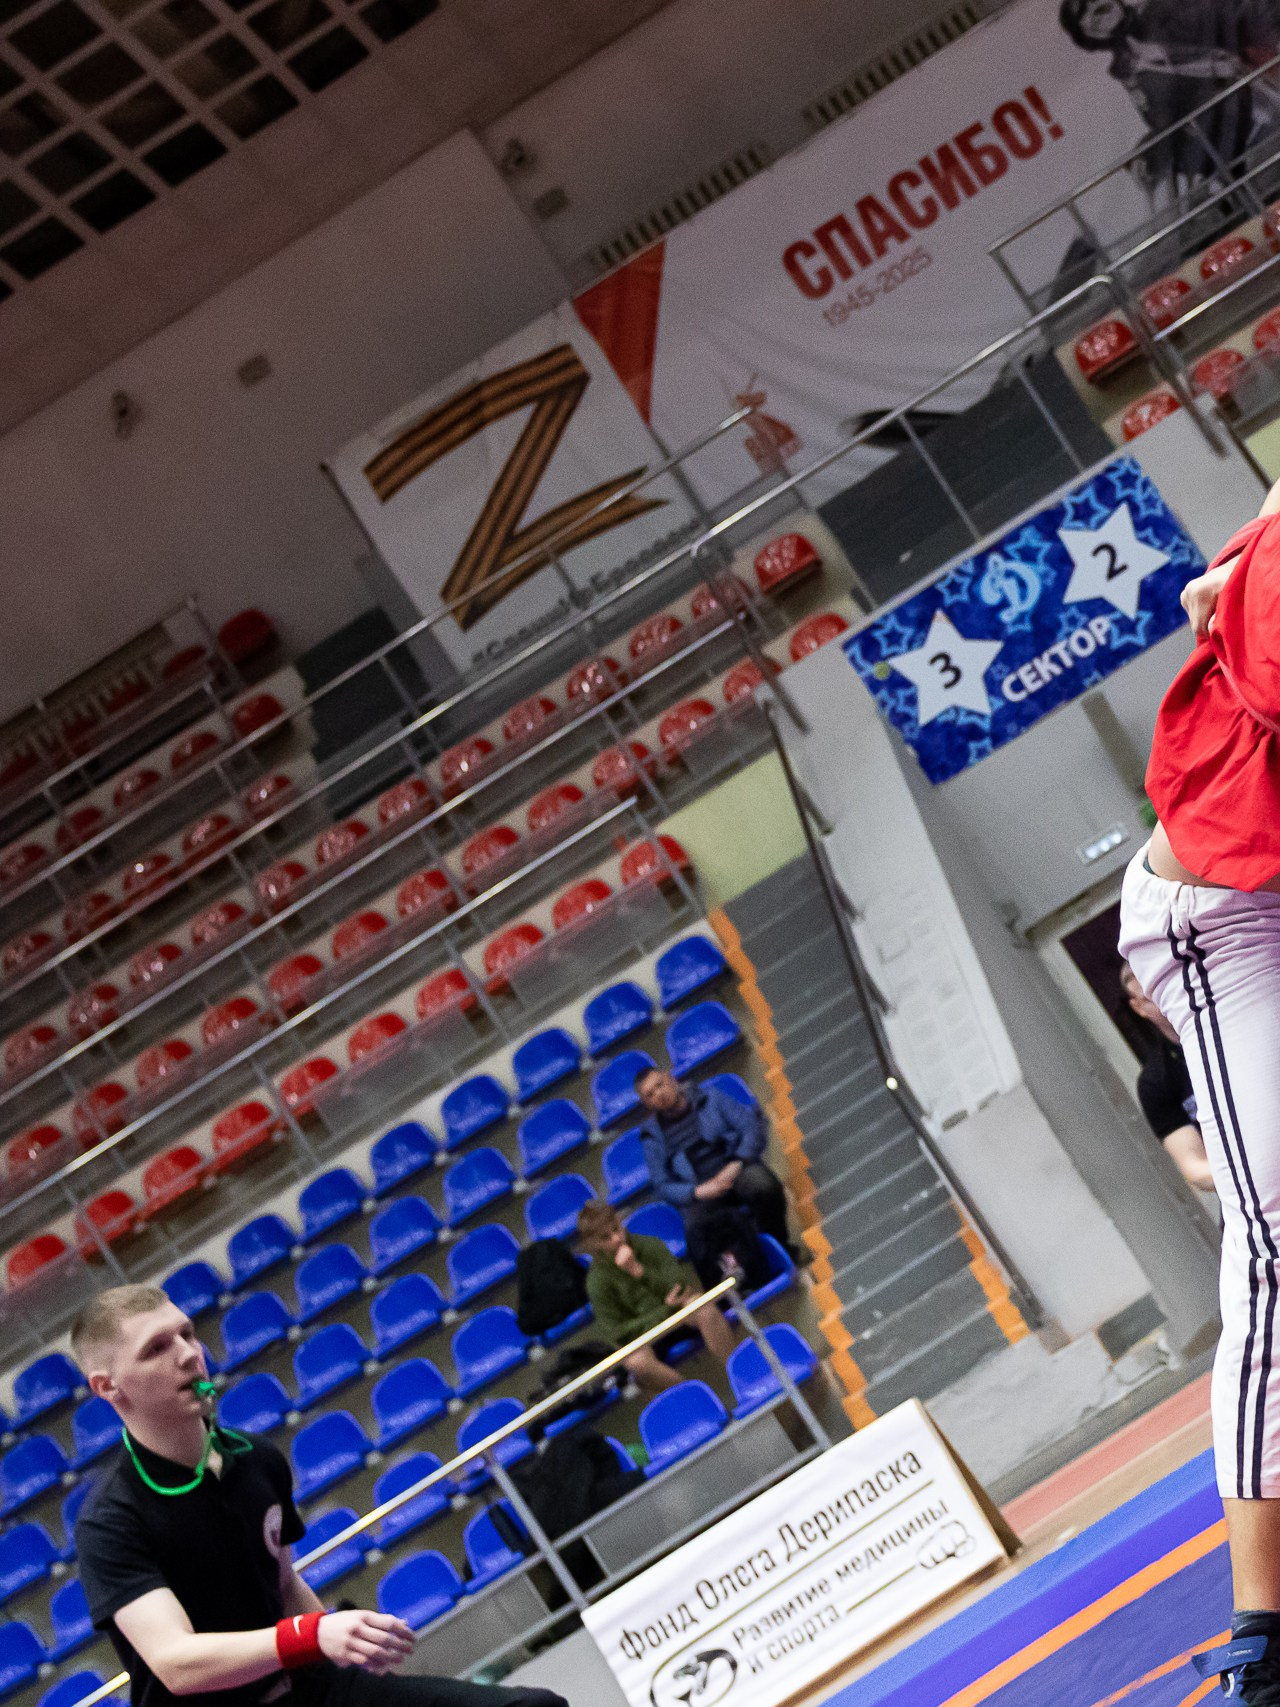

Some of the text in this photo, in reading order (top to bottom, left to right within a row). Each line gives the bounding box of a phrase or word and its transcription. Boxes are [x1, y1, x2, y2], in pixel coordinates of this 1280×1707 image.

[782, 85, 1066, 300] СПАСИБО!
[822, 245, 933, 327] 1945-2025
[1092, 543, 1128, 582] 2
[929, 653, 963, 689] 3
[1001, 615, 1112, 703] СЕКТОР
[618, 1608, 702, 1662] Фонд
[777, 1447, 924, 1562] Дерипаска
[732, 1496, 950, 1650] Развитие медицины
[747, 1602, 842, 1675] и спорта
